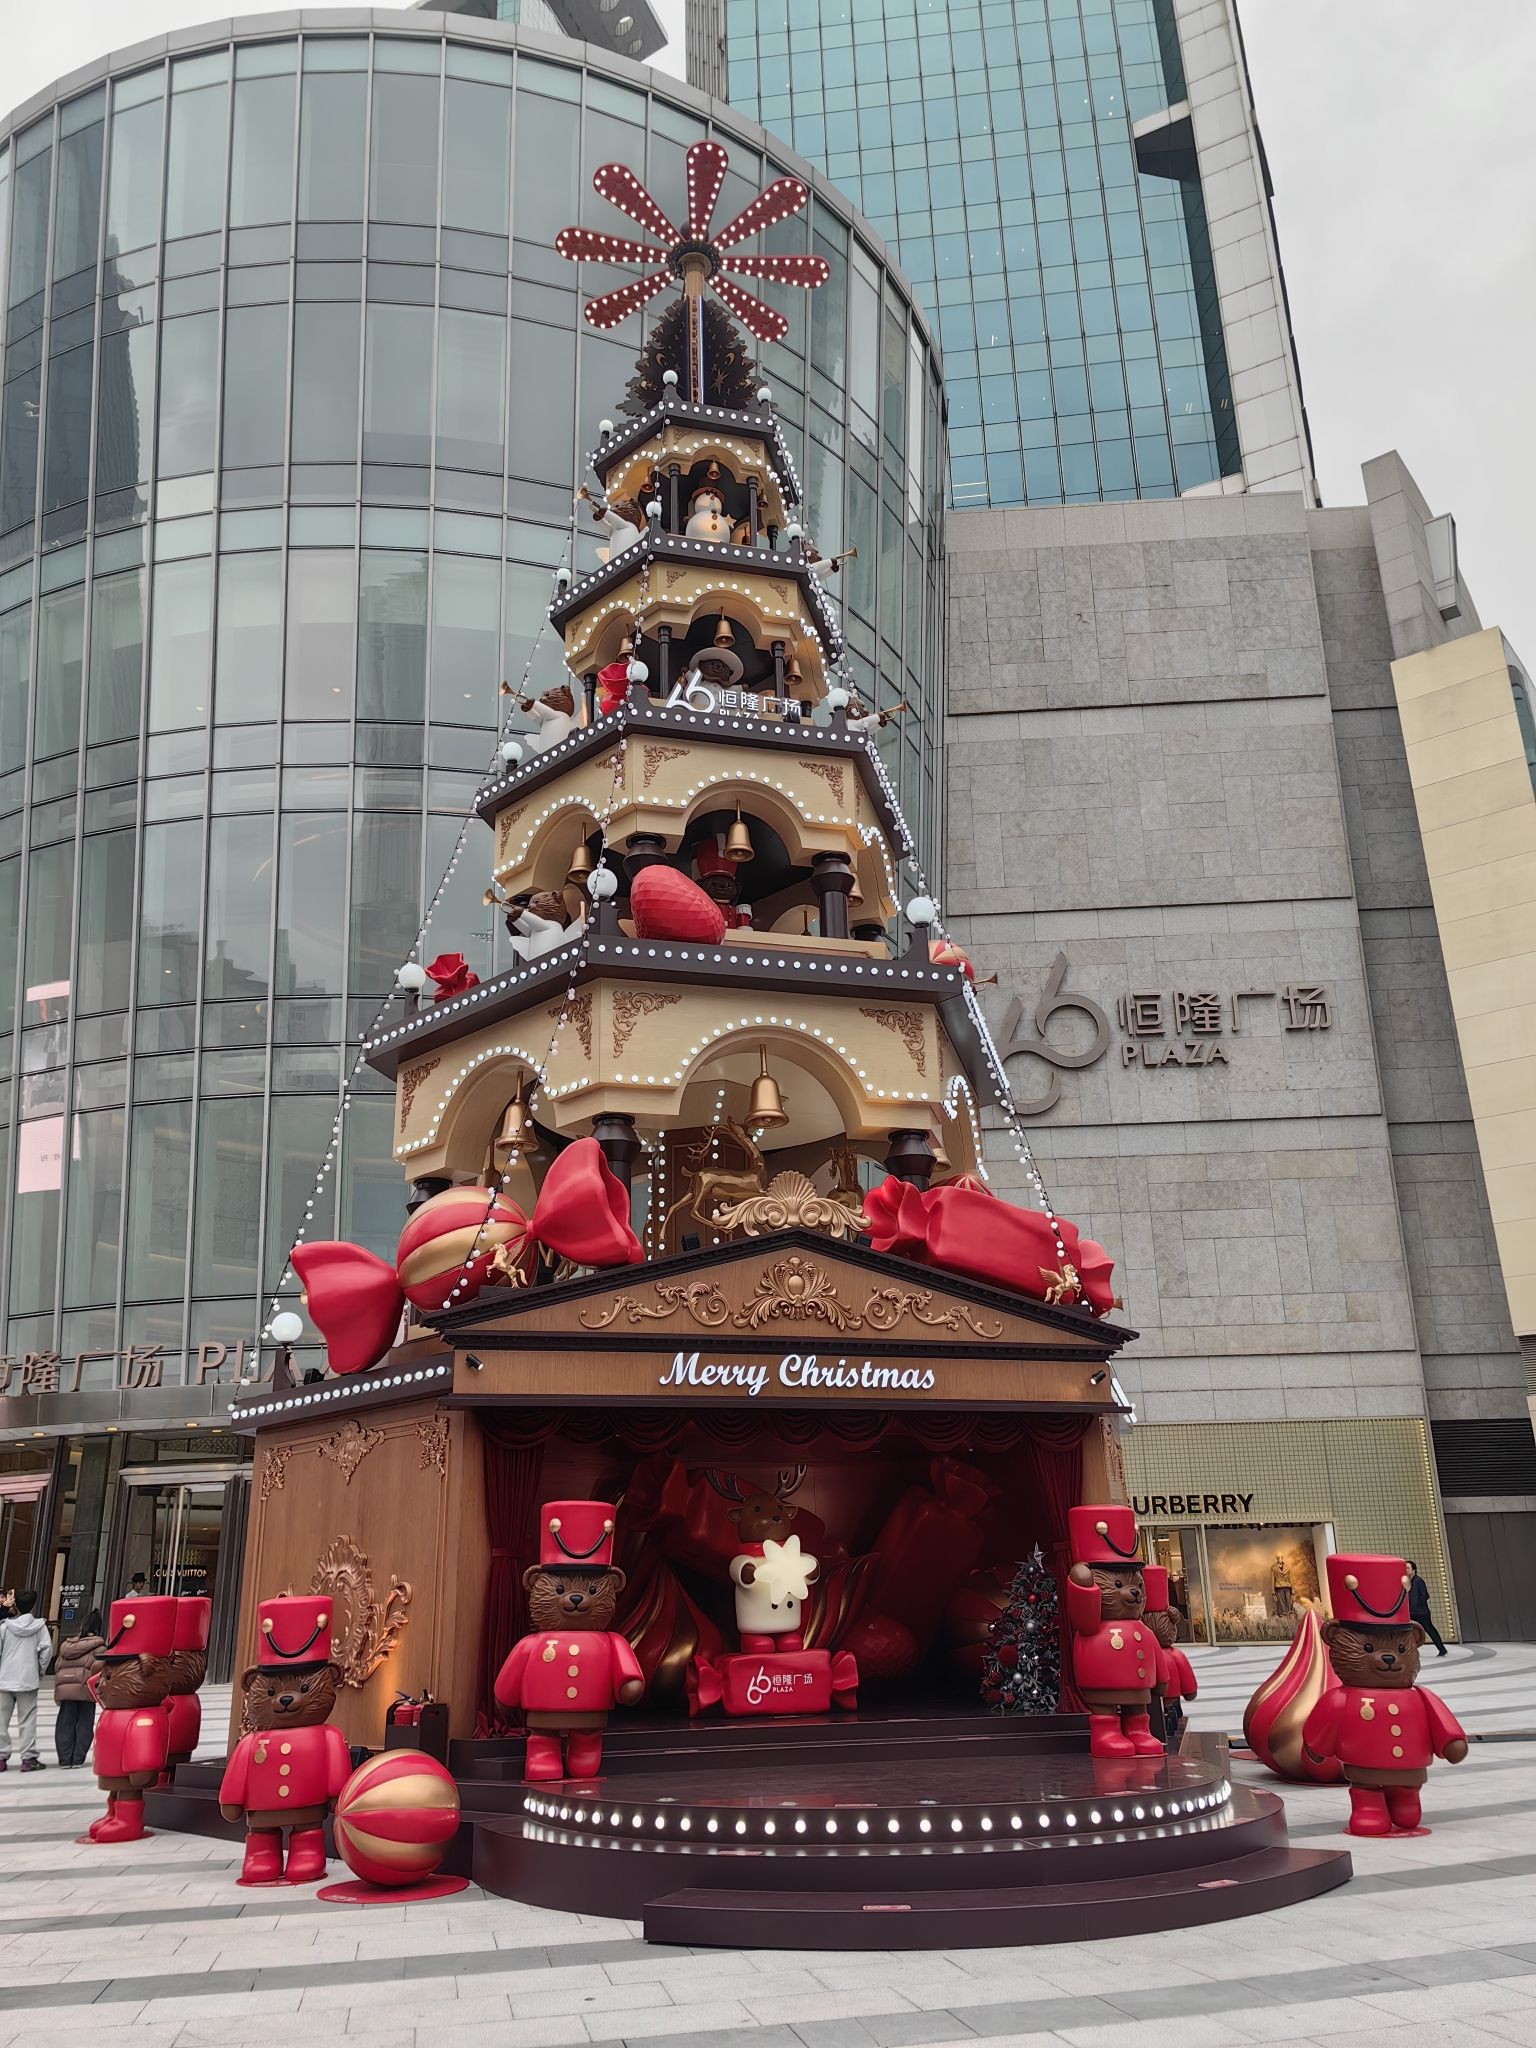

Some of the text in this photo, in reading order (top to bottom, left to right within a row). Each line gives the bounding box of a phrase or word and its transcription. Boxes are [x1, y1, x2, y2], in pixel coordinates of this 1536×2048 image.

[719, 690, 800, 715] 恒隆广场
[1117, 984, 1333, 1037] 恒隆广场
[1122, 1040, 1229, 1068] PLAZA
[659, 1352, 936, 1396] Merry Christmas
[1127, 1493, 1254, 1515] URBERRY
[772, 1673, 813, 1686] 恒隆广场
